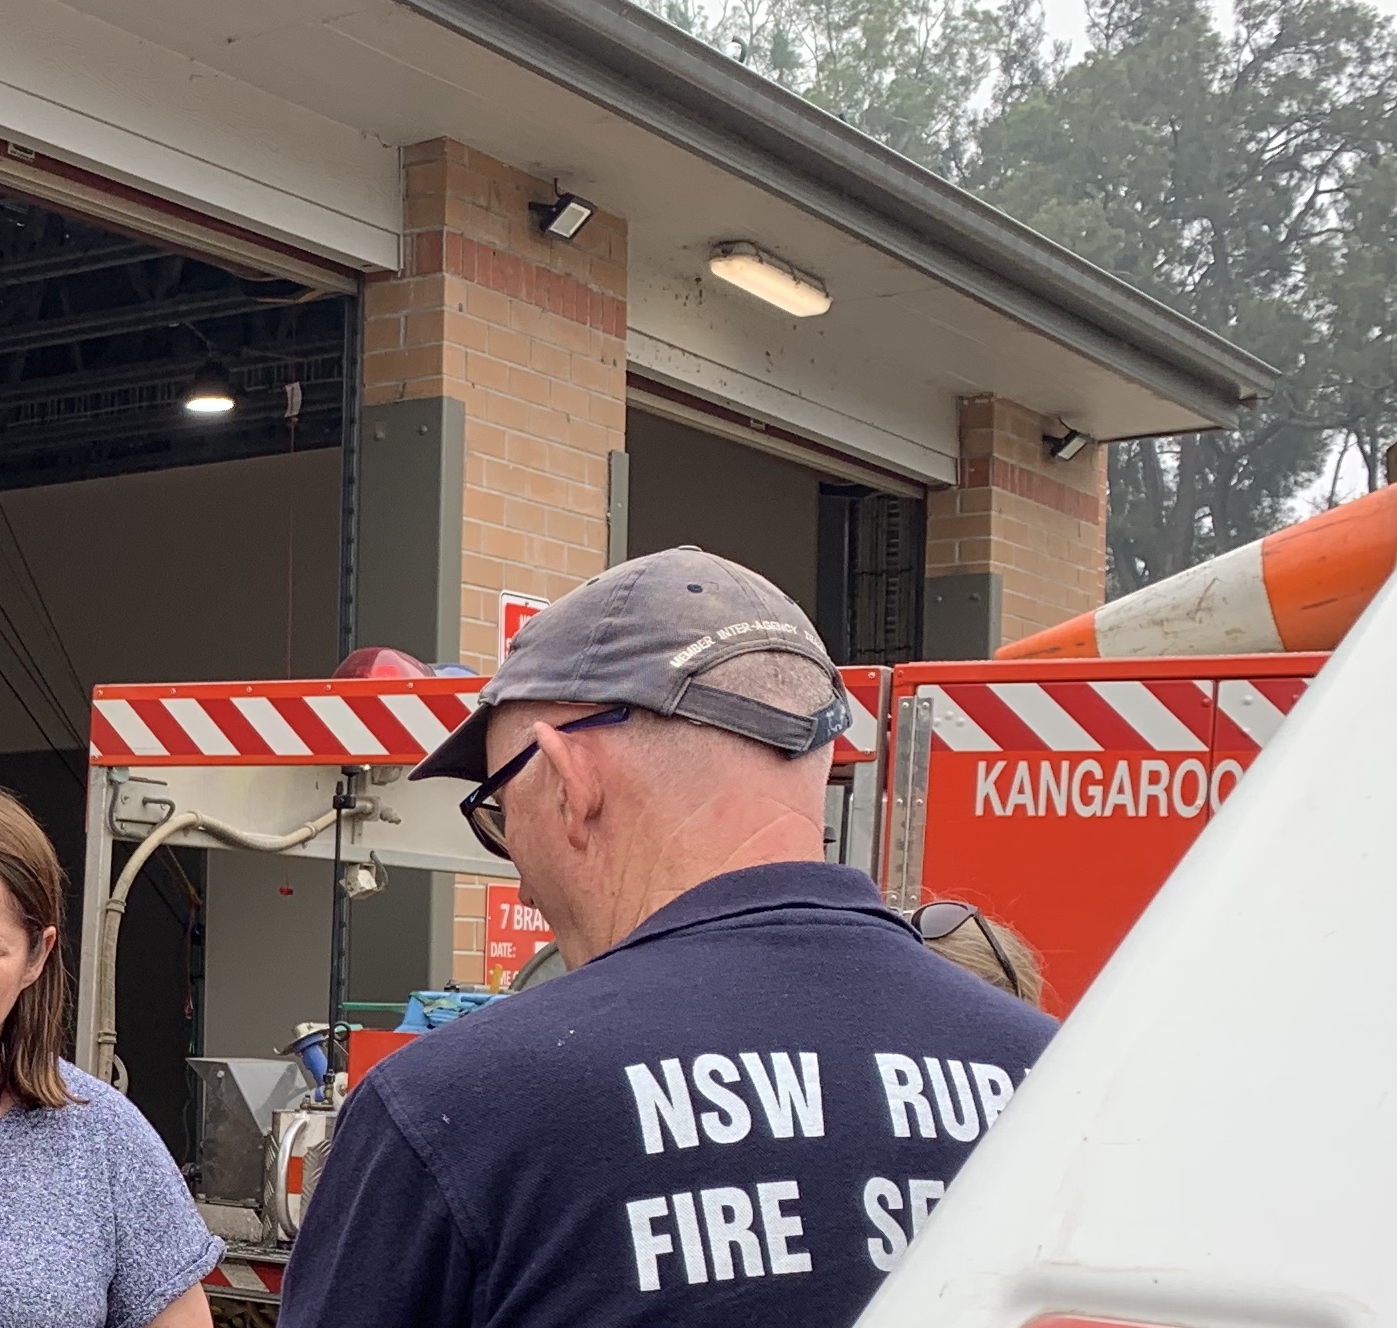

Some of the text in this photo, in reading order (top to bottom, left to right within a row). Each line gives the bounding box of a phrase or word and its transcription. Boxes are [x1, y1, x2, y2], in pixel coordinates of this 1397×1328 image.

[670, 620, 798, 668] MEMBER INTER-AGENCY
[500, 903, 510, 930] 7
[490, 941, 516, 958] DATE:
[624, 1051, 1031, 1155] NSW RUR
[625, 1180, 813, 1292] FIRE
